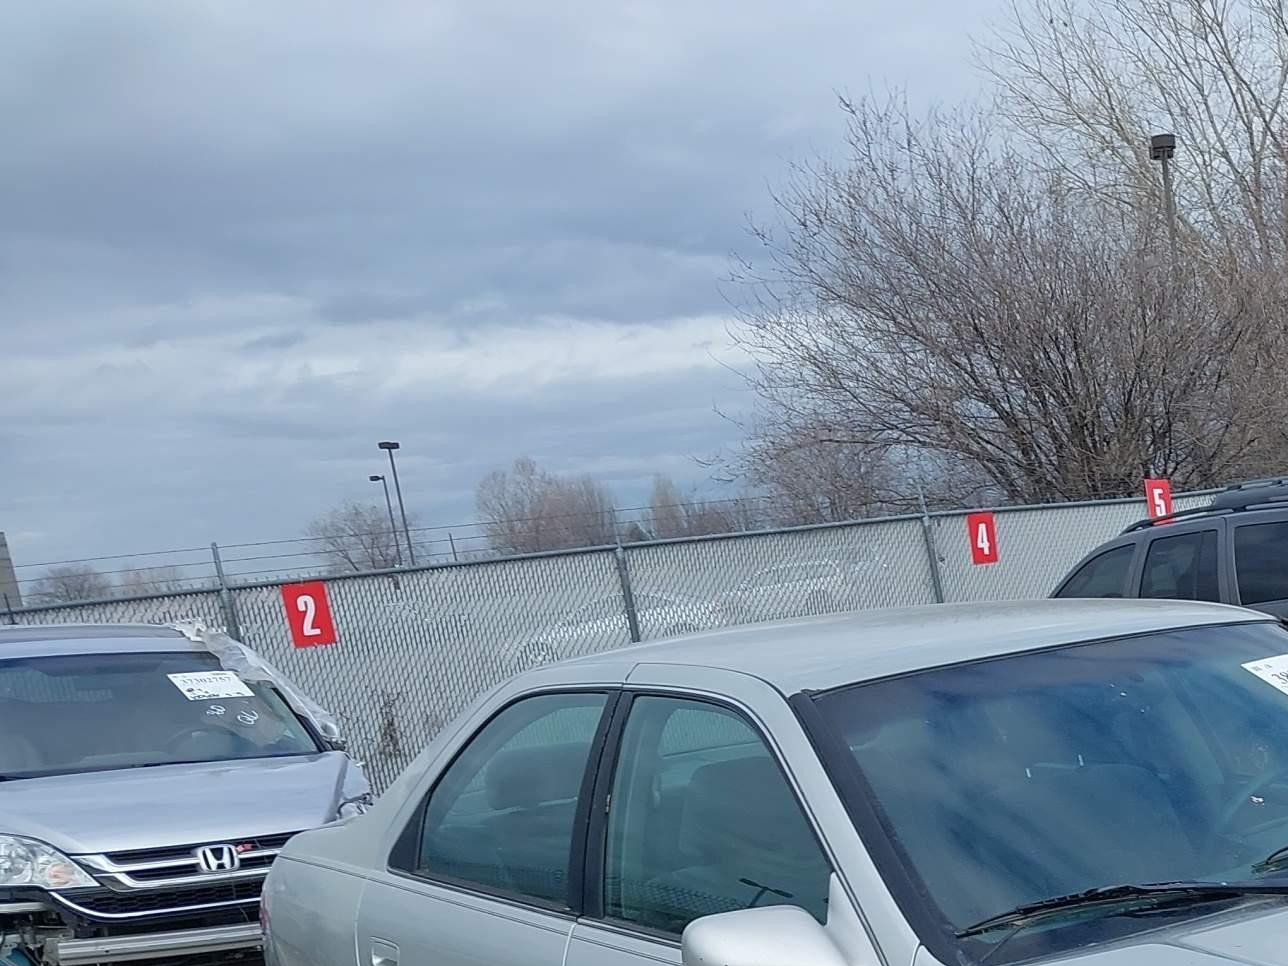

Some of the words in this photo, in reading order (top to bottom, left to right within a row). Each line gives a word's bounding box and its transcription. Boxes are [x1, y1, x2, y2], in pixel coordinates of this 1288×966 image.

[1152, 488, 1167, 517] 5
[977, 522, 991, 555] 4
[296, 594, 321, 636] 2
